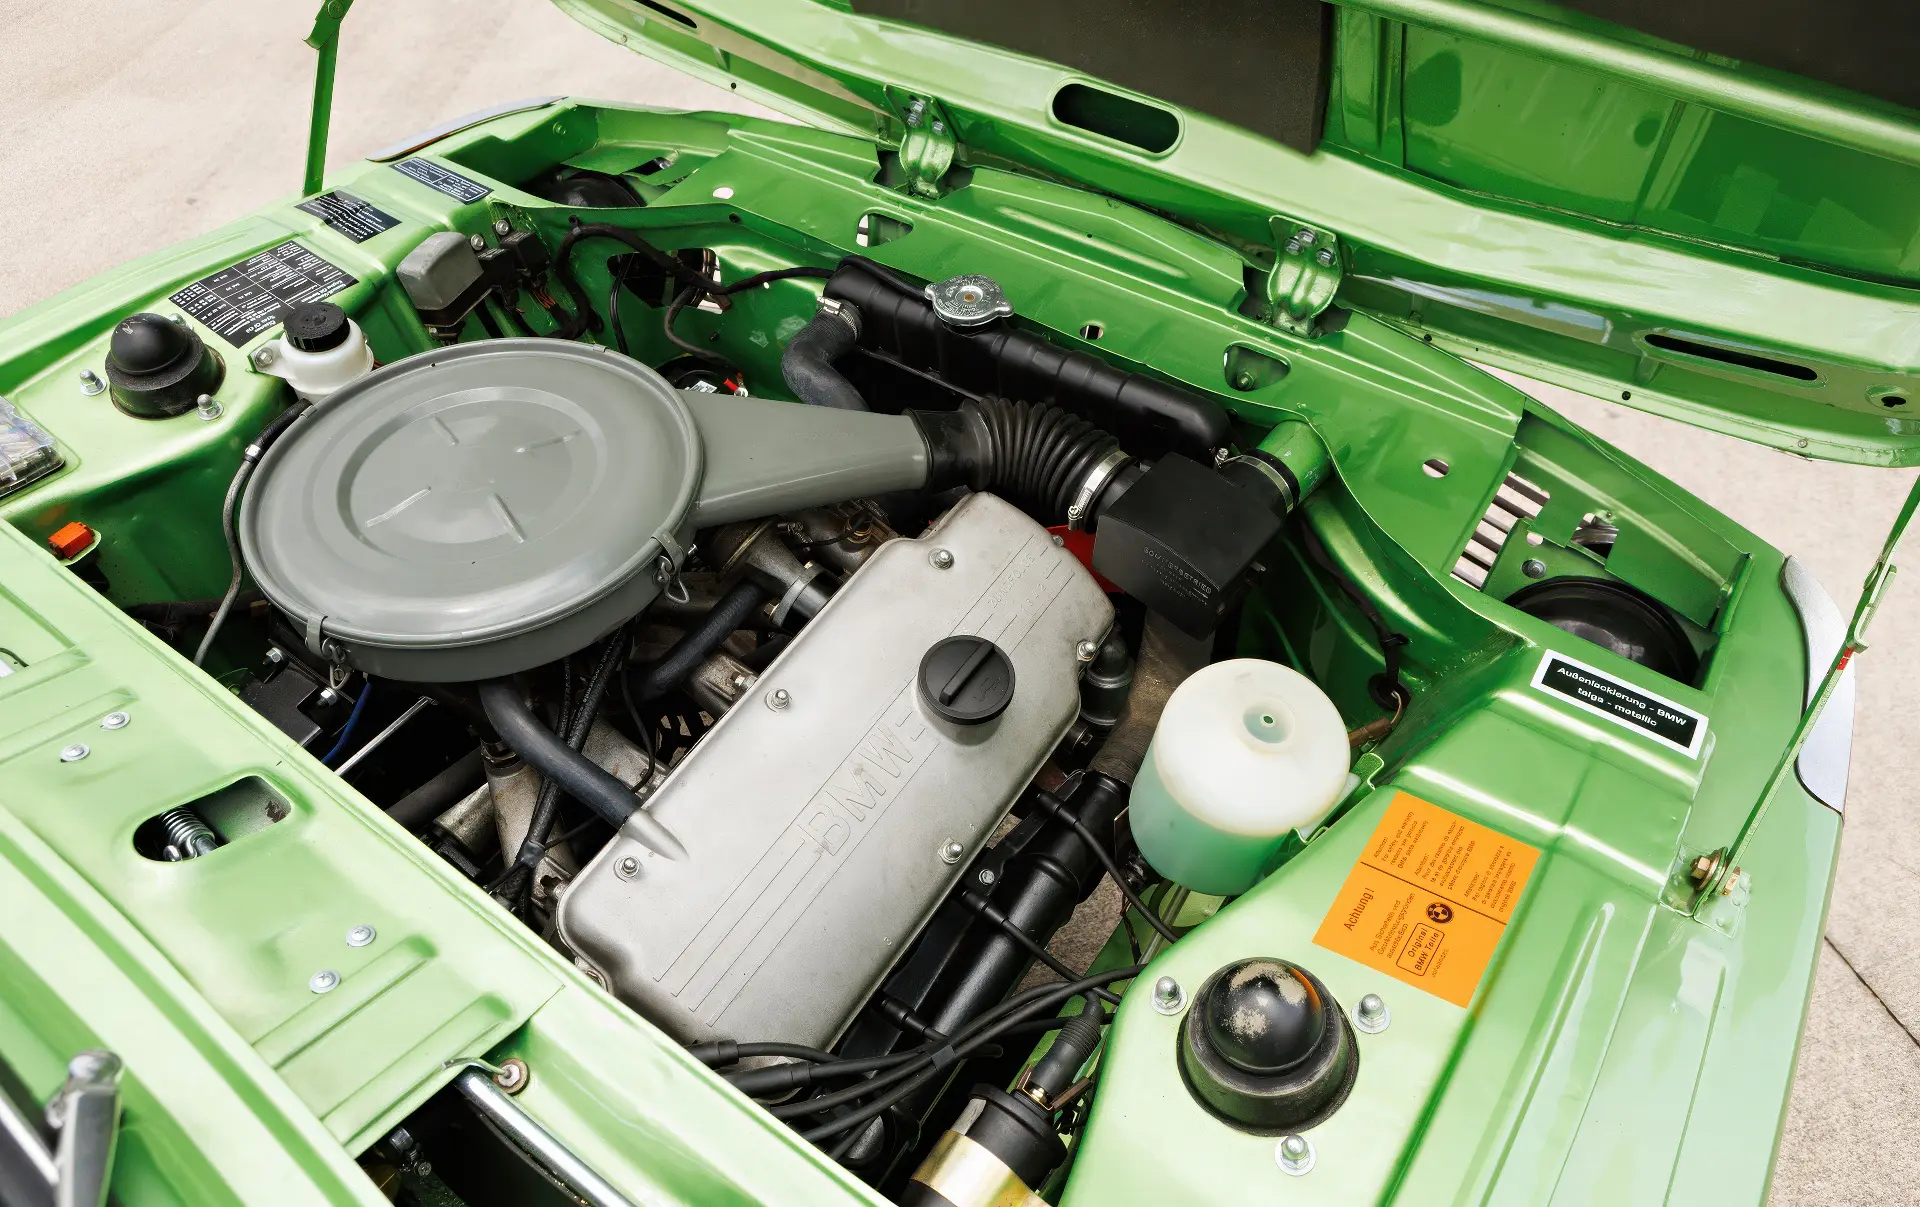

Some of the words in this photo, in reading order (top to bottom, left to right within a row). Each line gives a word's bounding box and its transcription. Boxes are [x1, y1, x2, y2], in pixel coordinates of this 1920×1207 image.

[1656, 708, 1687, 726] BMW
[797, 721, 914, 856] BMW
[1342, 886, 1376, 931] Achtung!
[1406, 926, 1428, 958] Original
[1414, 950, 1429, 971] BMW
[1424, 931, 1440, 950] Teile
